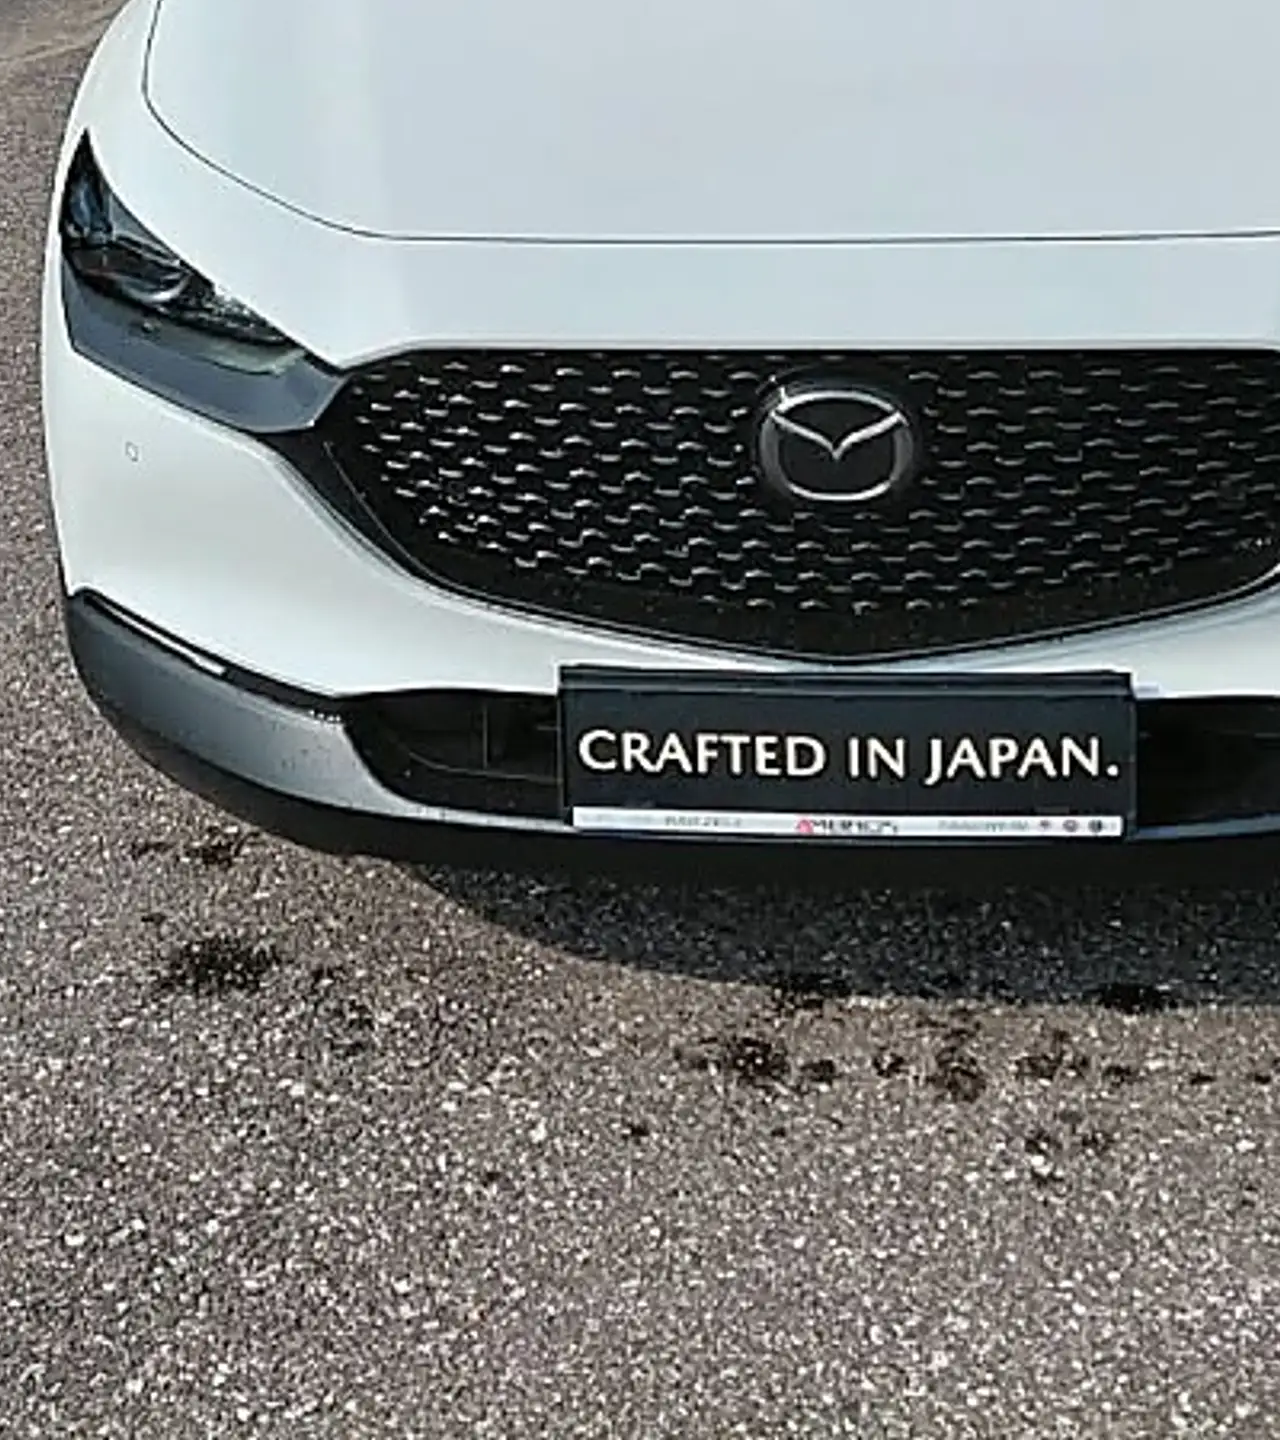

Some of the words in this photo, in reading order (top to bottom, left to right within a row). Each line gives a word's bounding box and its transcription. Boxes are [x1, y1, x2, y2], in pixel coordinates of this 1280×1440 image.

[577, 729, 827, 778] CRAFTED
[848, 735, 906, 779] IN
[923, 735, 1122, 786] JAPAN.
